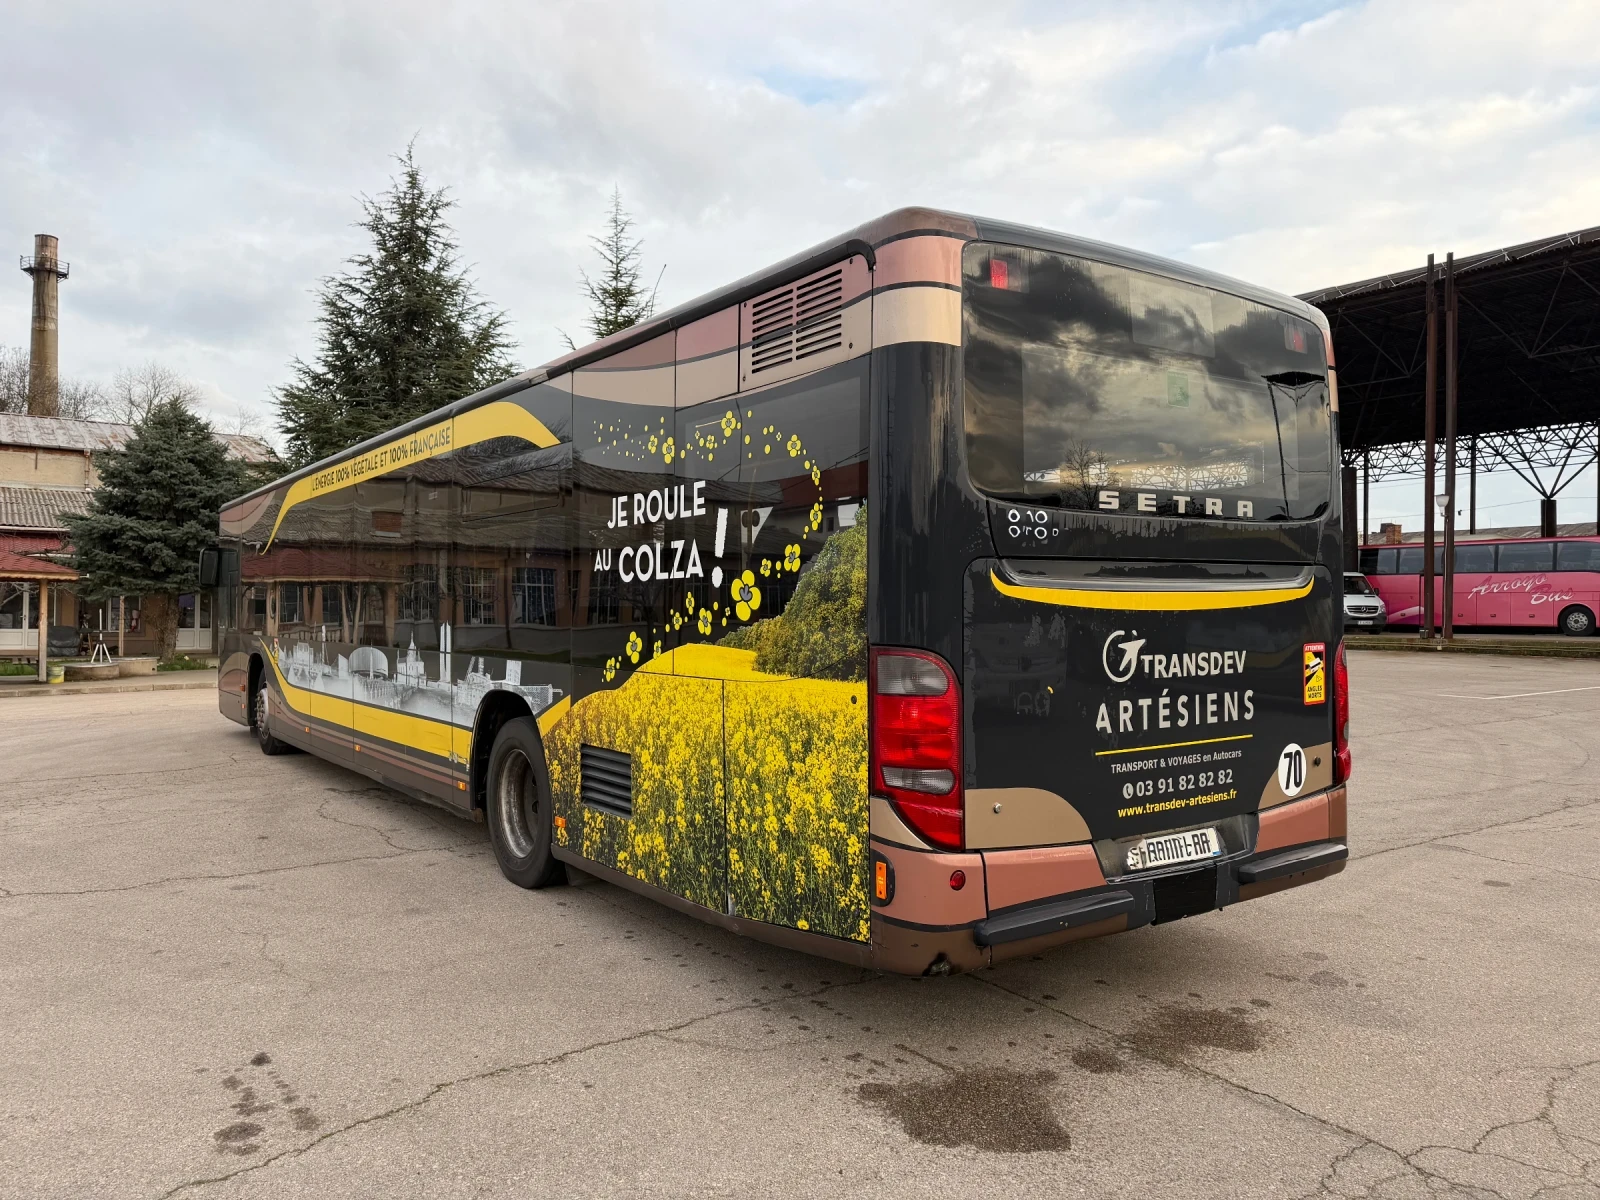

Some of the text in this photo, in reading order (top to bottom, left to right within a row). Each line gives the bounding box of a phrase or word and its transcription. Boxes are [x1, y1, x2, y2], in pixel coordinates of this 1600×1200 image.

[336, 468, 350, 481] 100%
[351, 455, 378, 477] VÉGÉTALE
[380, 450, 388, 467] ET
[389, 443, 408, 463] 100%
[410, 427, 450, 455] FRANÇAISE
[607, 480, 706, 529] JE ROULE
[1099, 490, 1254, 518] SETRA
[594, 548, 612, 572] AU
[618, 538, 704, 583] COLZA
[1467, 573, 1548, 600] Arroyo
[1530, 583, 1574, 605] Bus
[1140, 650, 1247, 679] TRANSDEV
[1095, 688, 1255, 734] ARTÉSIENS
[1111, 749, 1242, 773] TRANSPORT & VOYAGES en Autocars
[1283, 749, 1303, 790] 70
[1136, 768, 1233, 797] 03 91 82 82 82
[1118, 789, 1237, 817] www.transdev-artesiens.fr
